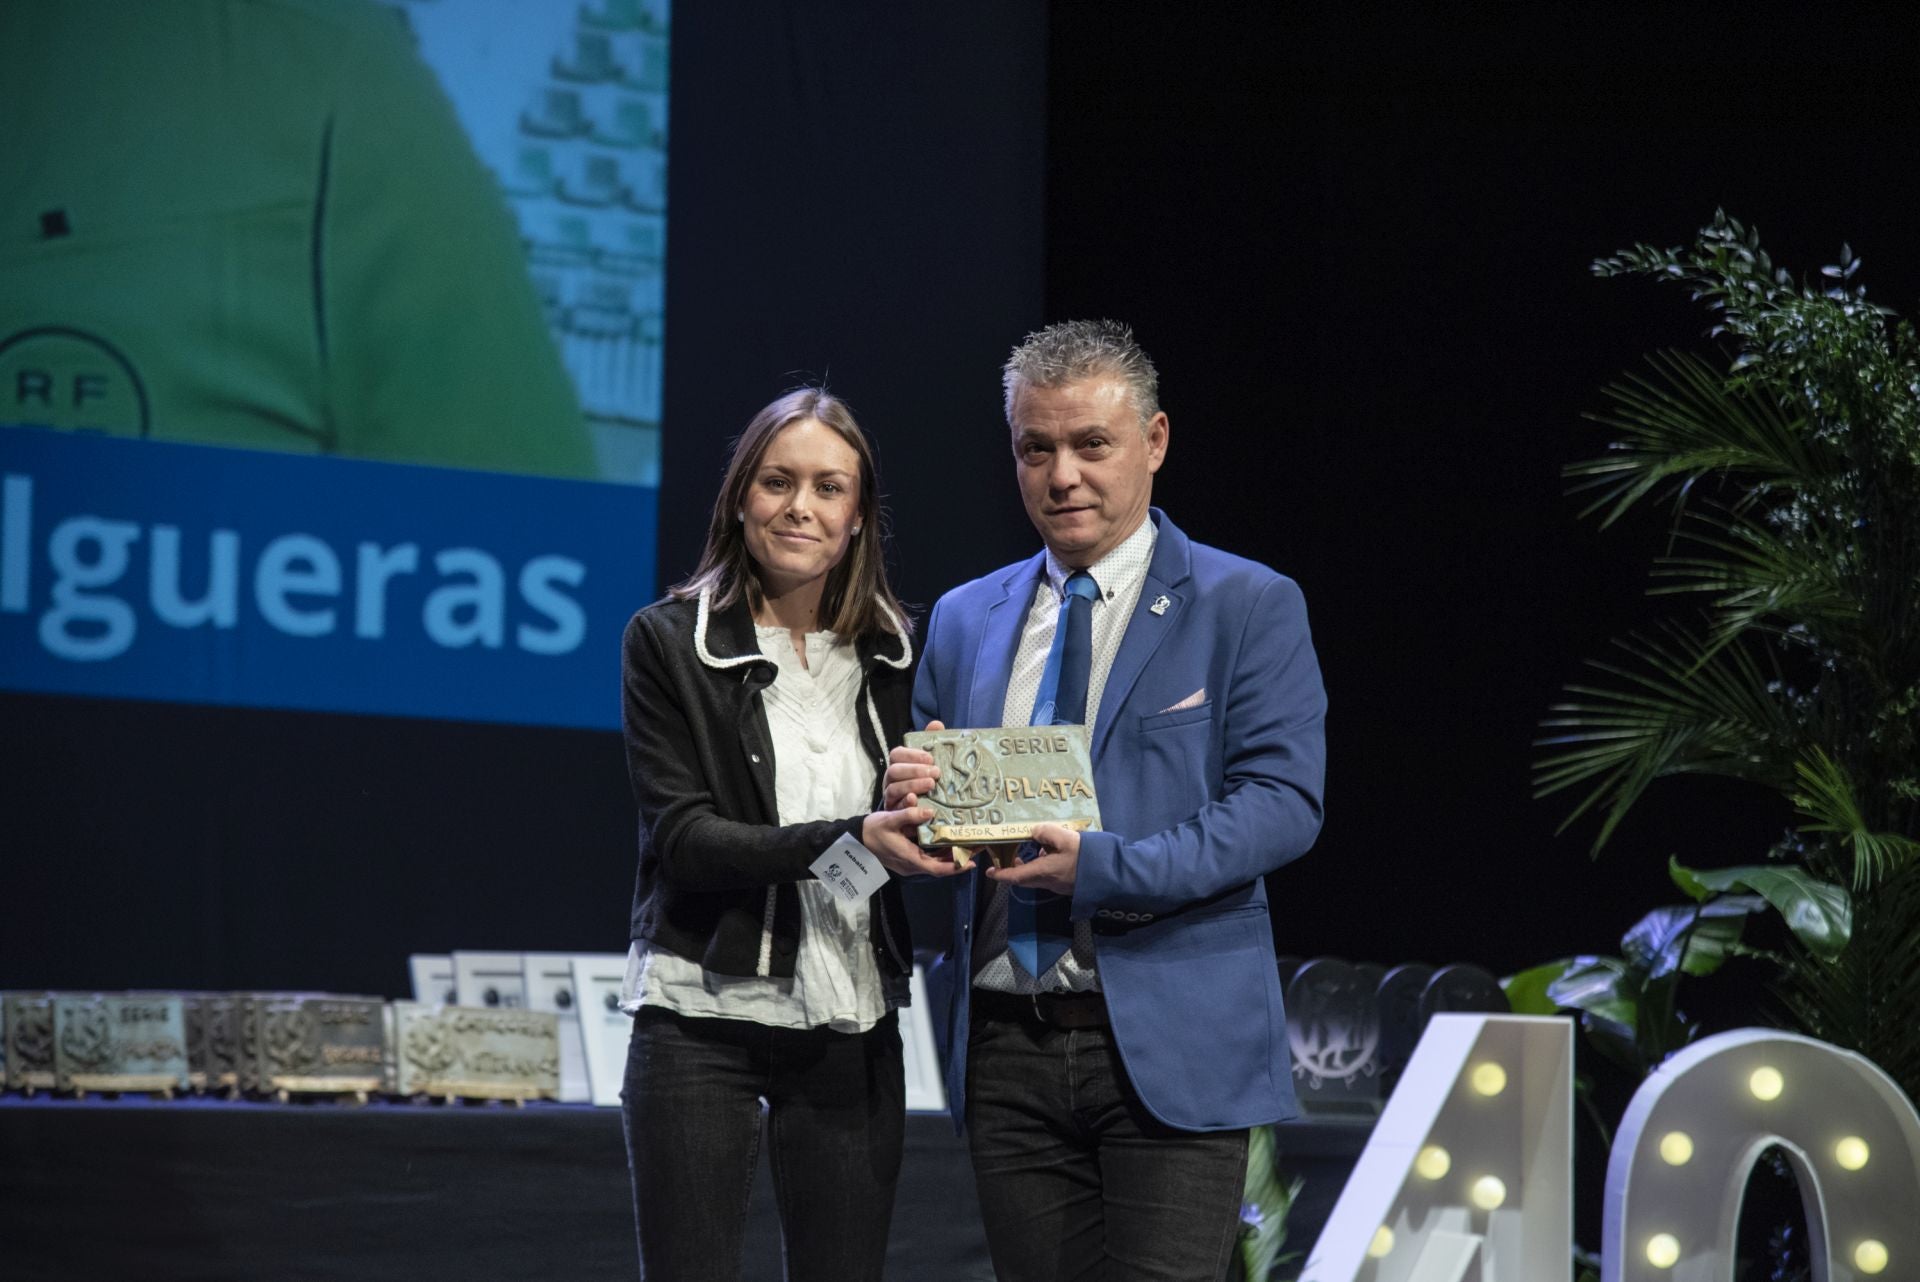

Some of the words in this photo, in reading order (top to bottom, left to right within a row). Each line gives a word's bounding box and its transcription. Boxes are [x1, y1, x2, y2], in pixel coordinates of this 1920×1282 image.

[1, 474, 587, 661] lgueras
[999, 735, 1069, 756] SERIE
[1005, 775, 1094, 803] PLATA
[931, 809, 1004, 826] ASPD
[950, 826, 994, 838] NÉSTOR
